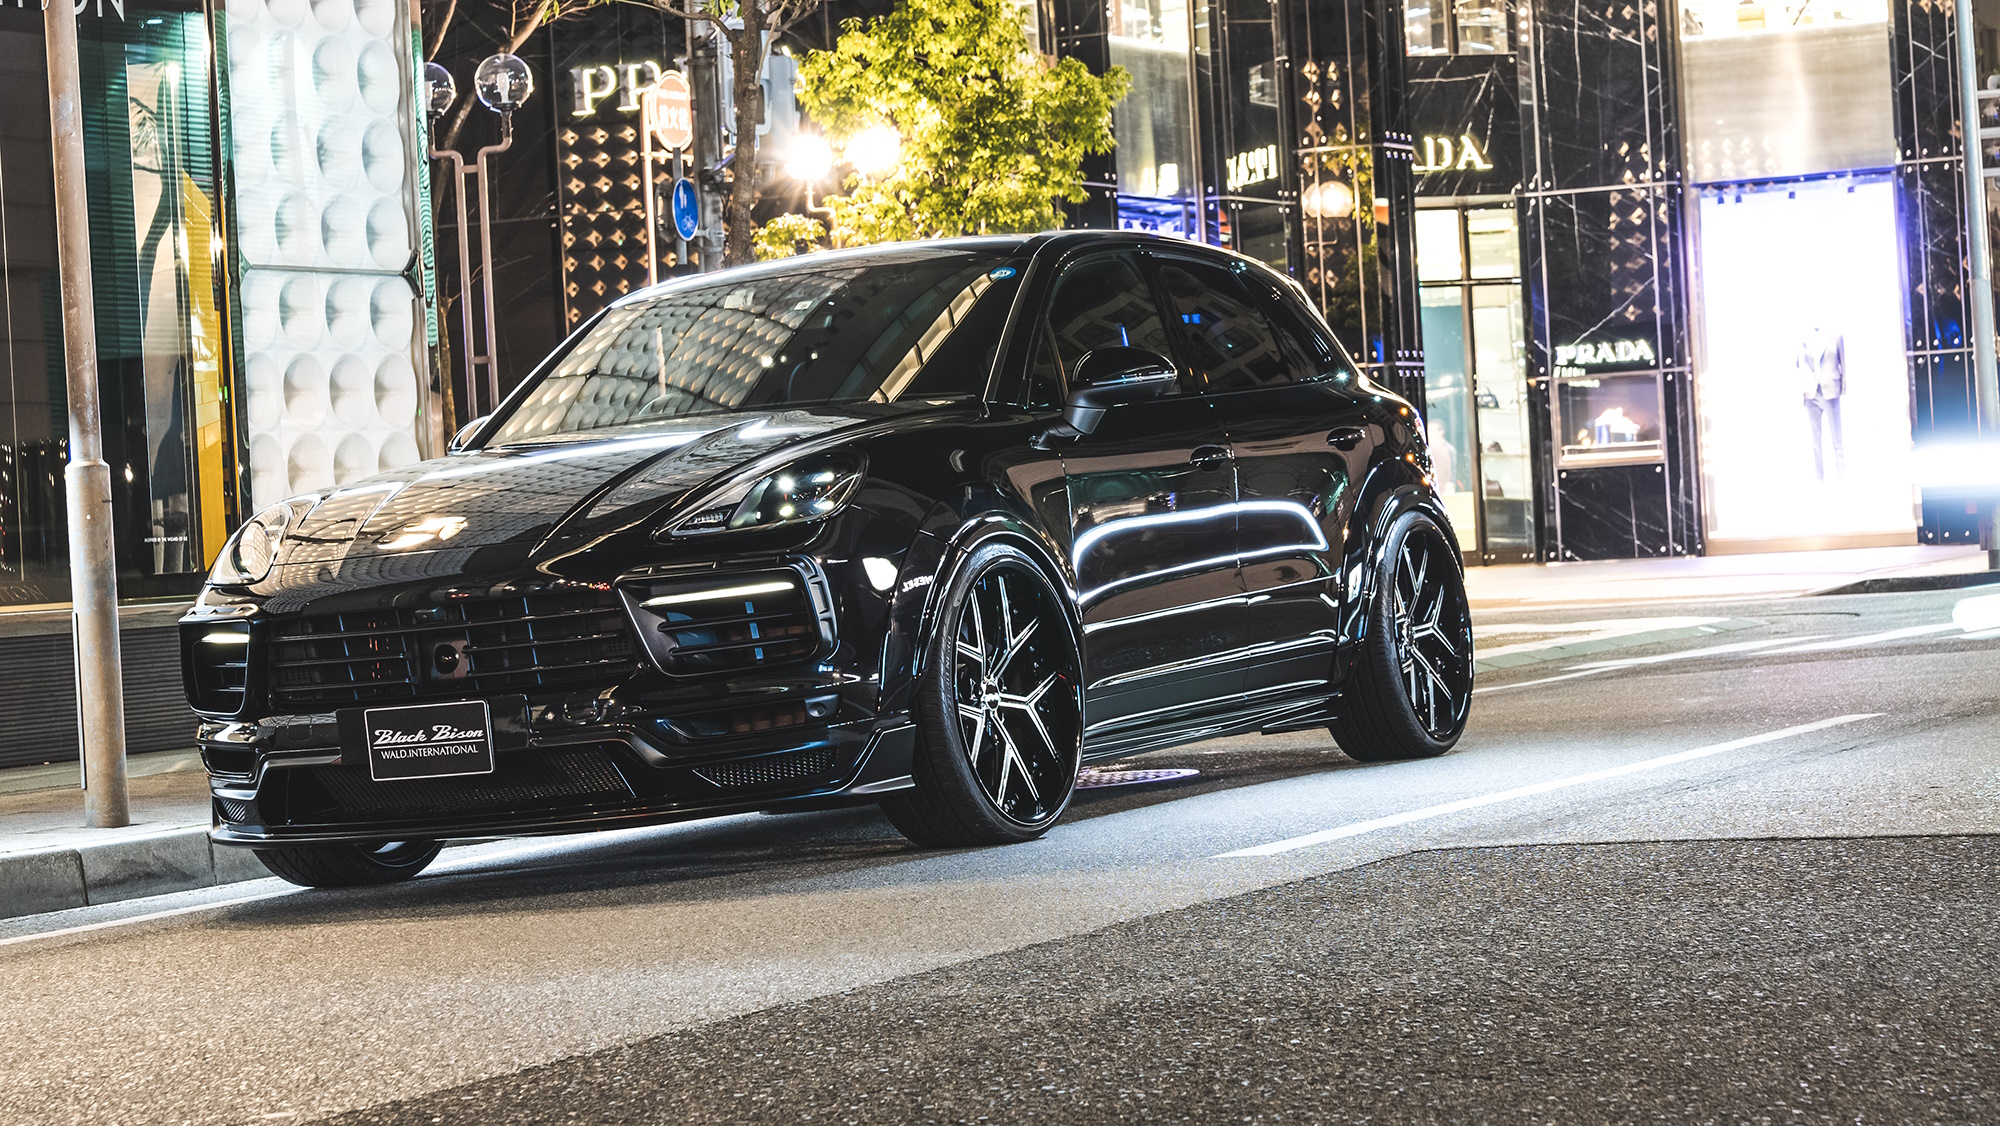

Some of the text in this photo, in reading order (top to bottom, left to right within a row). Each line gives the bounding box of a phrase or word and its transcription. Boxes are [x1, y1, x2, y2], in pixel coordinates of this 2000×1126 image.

[1411, 135, 1494, 172] DA
[1555, 339, 1655, 366] PRADA
[373, 724, 484, 746] Black Bison
[380, 744, 479, 760] WALD.INTERNATIONAL
